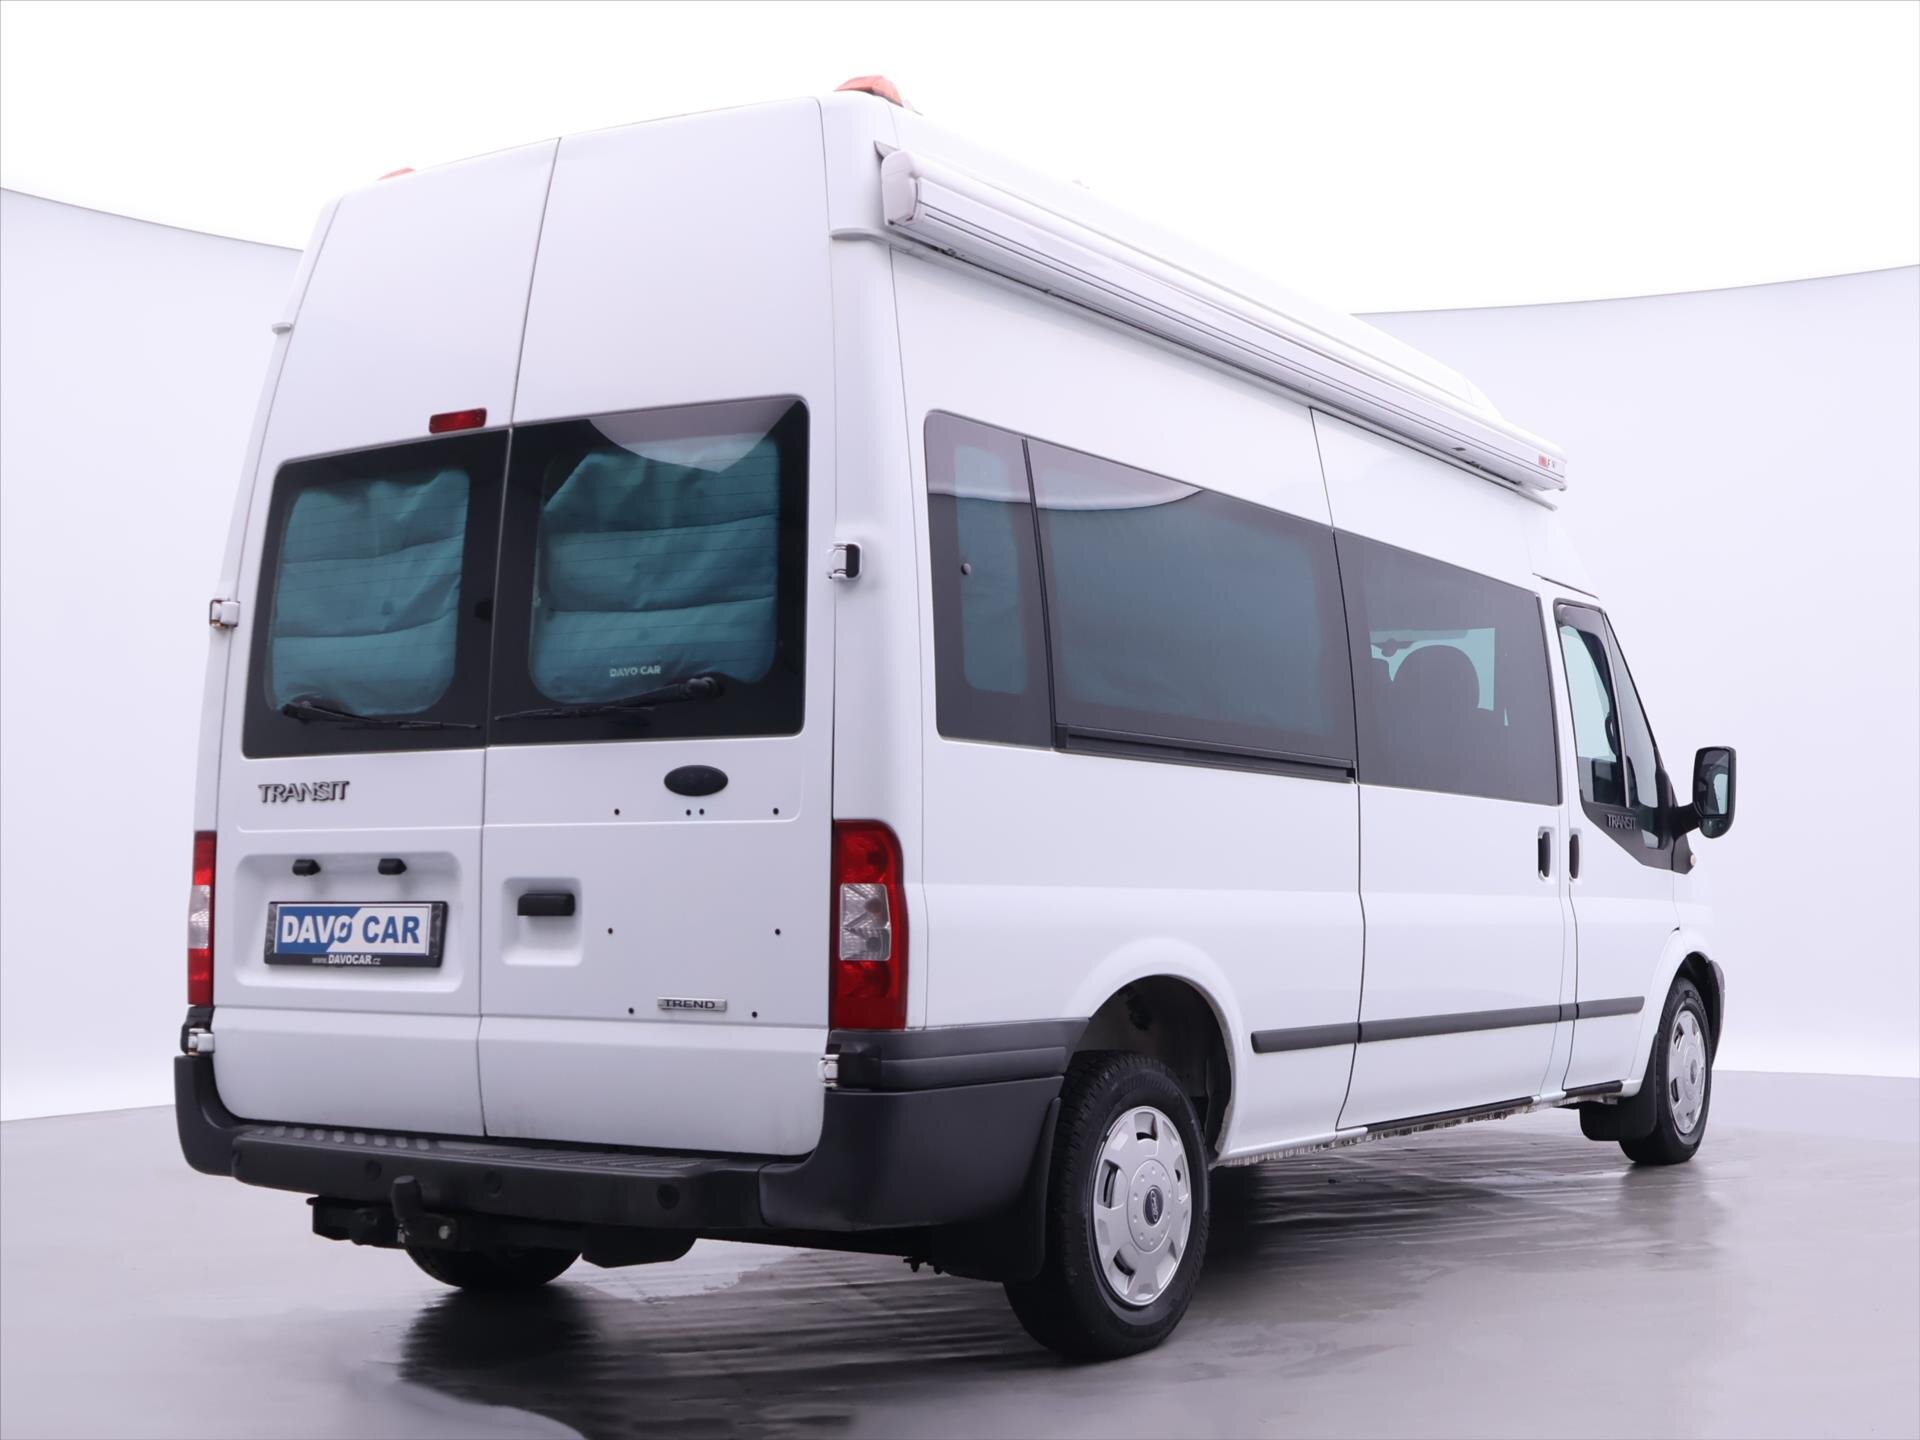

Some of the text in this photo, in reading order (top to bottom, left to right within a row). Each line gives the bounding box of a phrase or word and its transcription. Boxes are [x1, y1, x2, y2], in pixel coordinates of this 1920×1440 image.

[640, 665, 661, 675] CAR
[258, 781, 350, 803] TRANSIT
[1607, 814, 1637, 830] TRANSIT
[281, 915, 420, 944] DAVO CAR
[663, 999, 716, 1009] TREND
